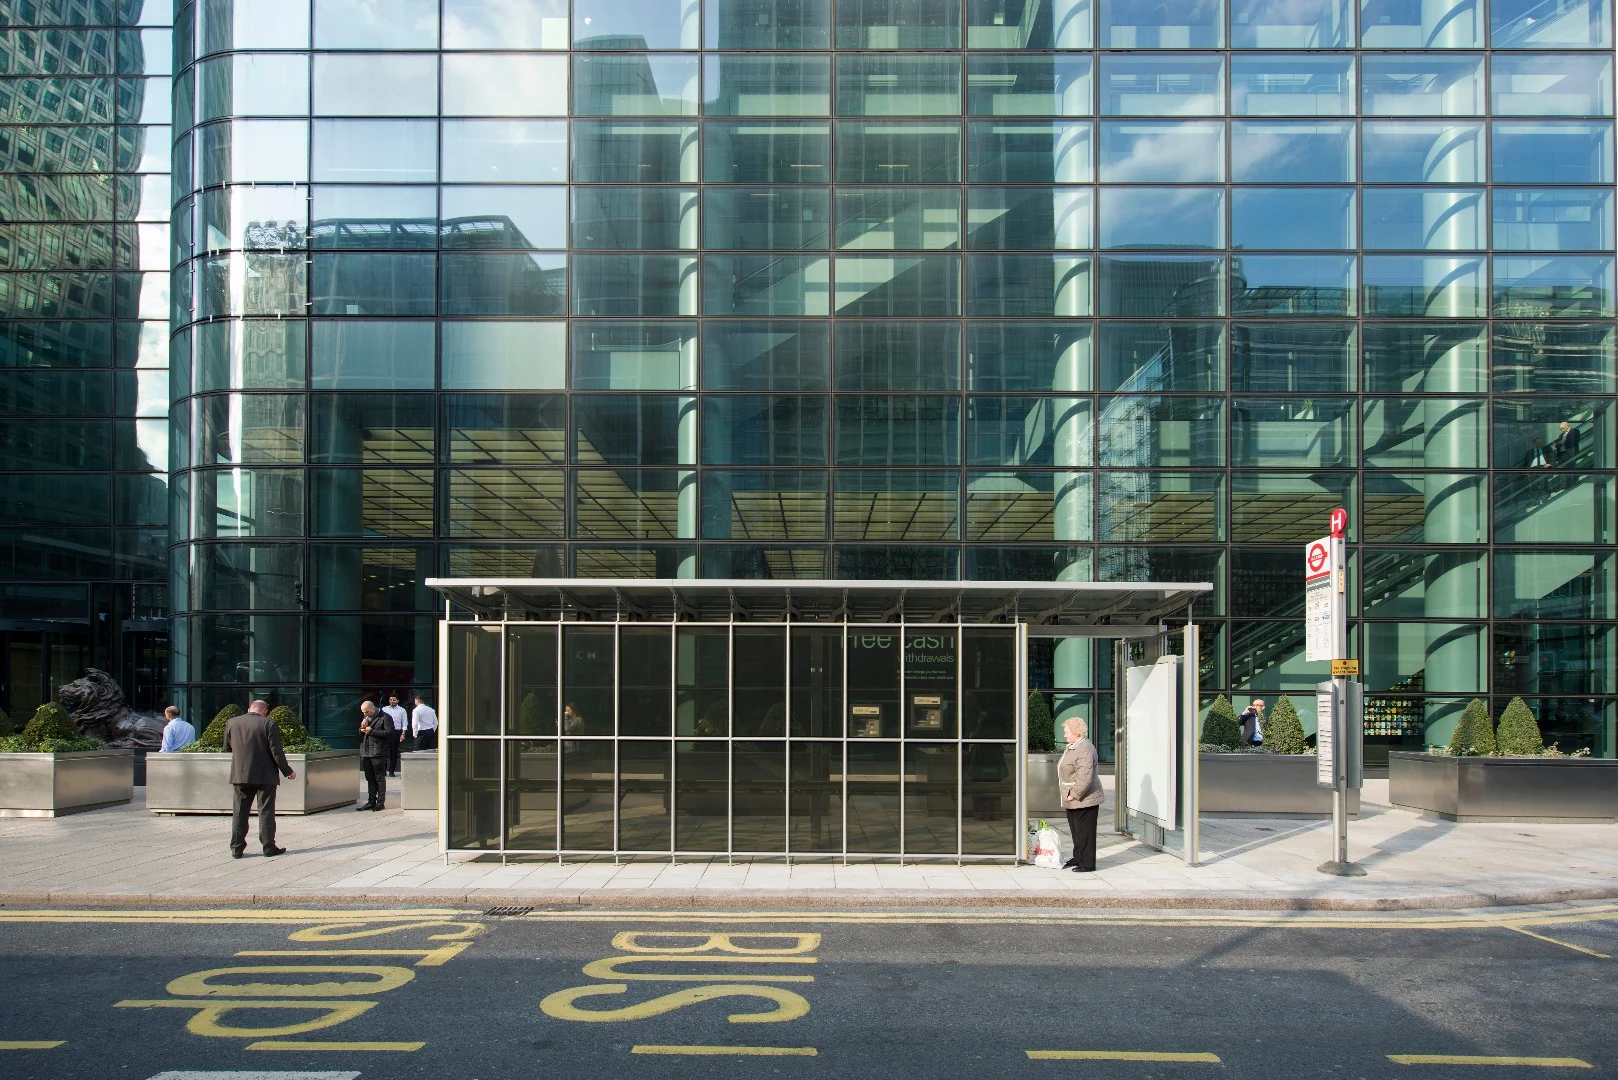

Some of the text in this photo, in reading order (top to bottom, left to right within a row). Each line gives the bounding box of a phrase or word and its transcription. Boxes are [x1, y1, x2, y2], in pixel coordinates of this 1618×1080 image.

[1331, 512, 1342, 533] H
[897, 652, 954, 663] ithdrawals
[112, 919, 487, 1037] STOP
[539, 931, 821, 1023] BUS
